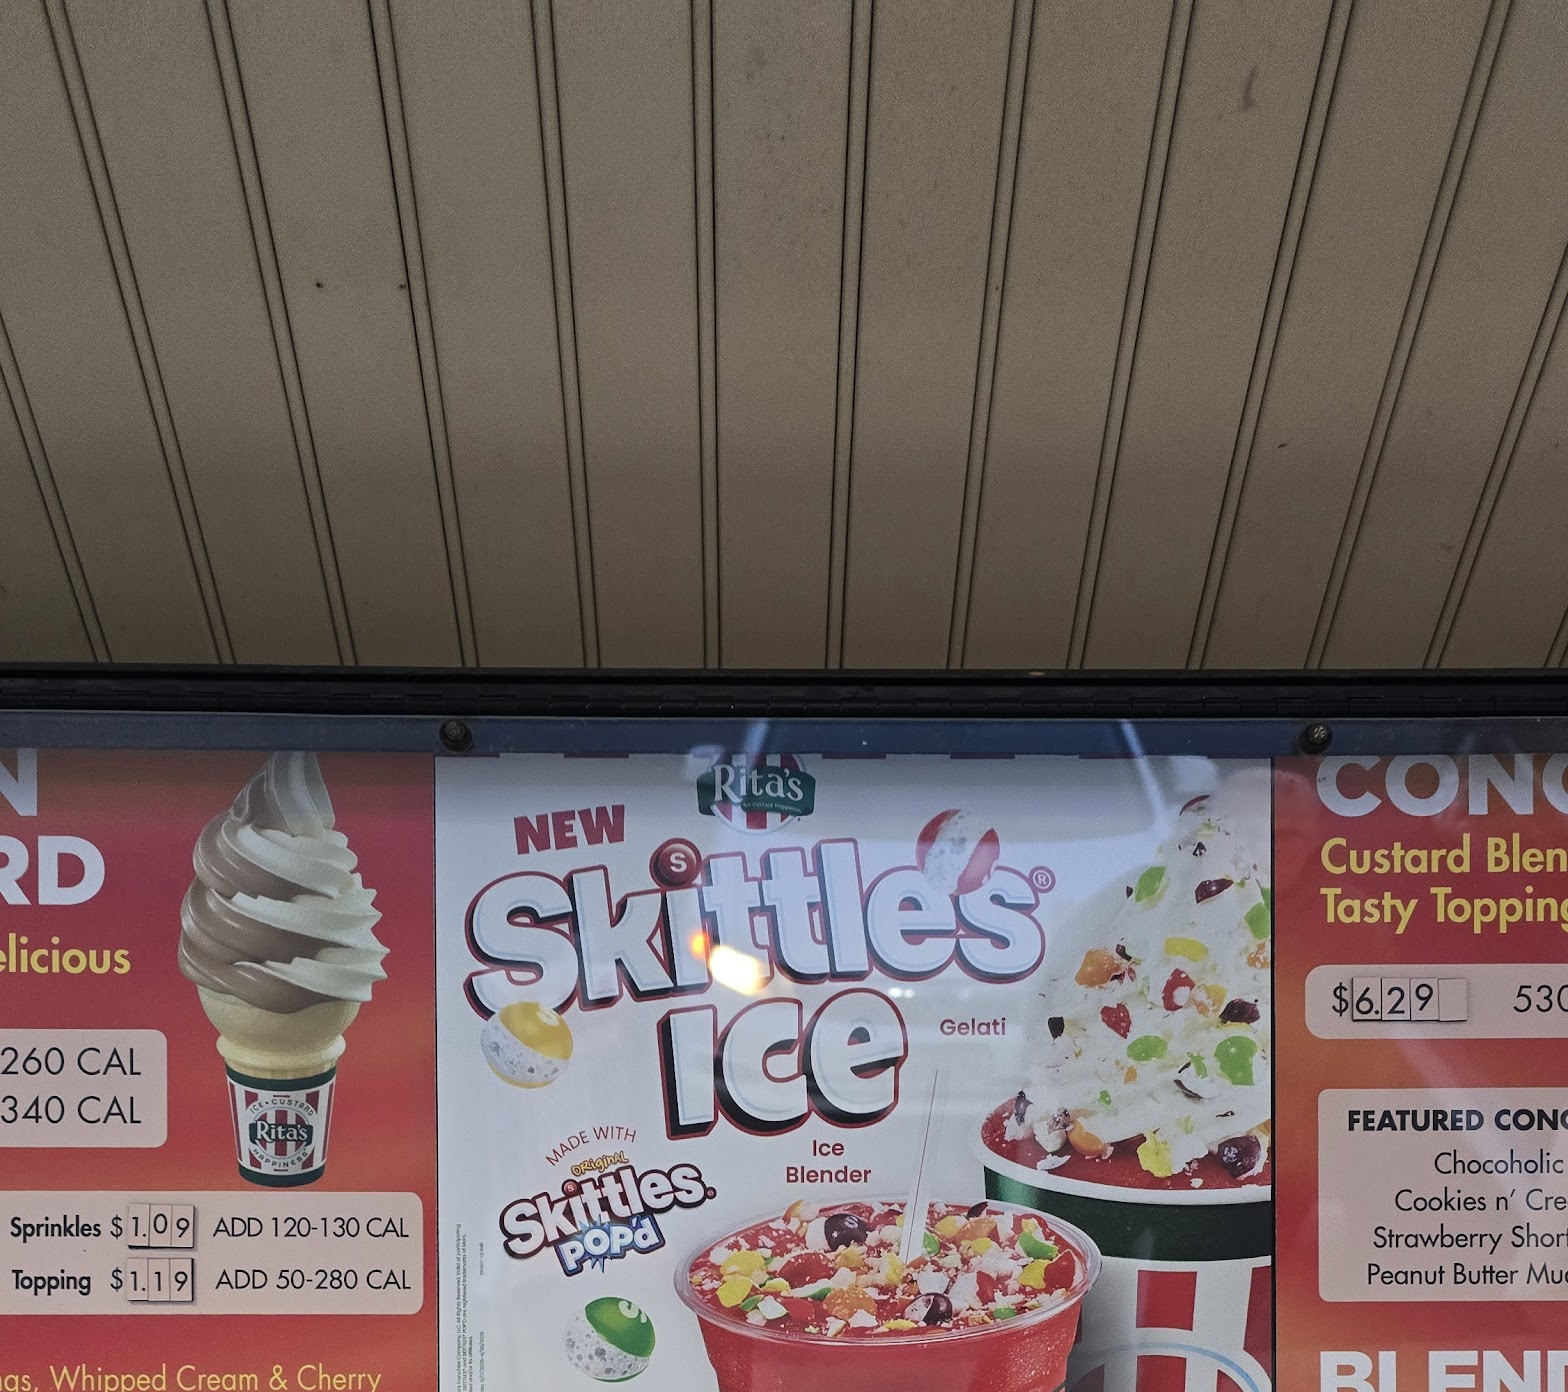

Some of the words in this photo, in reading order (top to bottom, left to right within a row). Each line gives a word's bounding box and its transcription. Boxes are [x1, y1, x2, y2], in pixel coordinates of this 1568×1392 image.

[713, 764, 803, 803] Rita's
[513, 805, 625, 855] NEW
[1320, 832, 1471, 875] Custard
[1320, 886, 1419, 935] Tasty
[0, 932, 131, 974] licious
[1332, 982, 1434, 1017] $6.29
[940, 1017, 1006, 1037] Gelati
[0, 1047, 65, 1075] 260
[77, 1047, 141, 1075] CAL
[0, 1095, 65, 1124] 340
[77, 1095, 141, 1124] CAL
[250, 1102, 264, 1114] ICE
[271, 1098, 314, 1117] CUSTARD
[1348, 1109, 1484, 1132] FEATURED
[256, 1120, 308, 1143] Rita's
[546, 1130, 589, 1166] MADE
[593, 1125, 636, 1143] WITH
[253, 1148, 308, 1168] HAPPINESS
[813, 1139, 844, 1157] Ice
[1434, 1149, 1564, 1175] Chocoholic
[785, 1166, 871, 1183] Blender
[1395, 1187, 1487, 1212] Cookies
[10, 1214, 101, 1243] Sprinkles
[110, 1213, 190, 1240] $1.09
[213, 1217, 263, 1237] ADD
[271, 1217, 360, 1238] 120-130
[366, 1217, 410, 1238] CAL
[1373, 1223, 1502, 1255] Strawberry
[11, 1269, 91, 1296] Topping
[110, 1266, 188, 1292] $1.19
[216, 1269, 267, 1289] ADD
[276, 1269, 358, 1290] 50-280
[366, 1269, 412, 1289] CAL
[1367, 1263, 1444, 1285] Peanut
[1453, 1263, 1518, 1285] Butter
[1526, 1262, 1568, 1285] Mu
[176, 1364, 259, 1392] Cream
[269, 1365, 289, 1392] &
